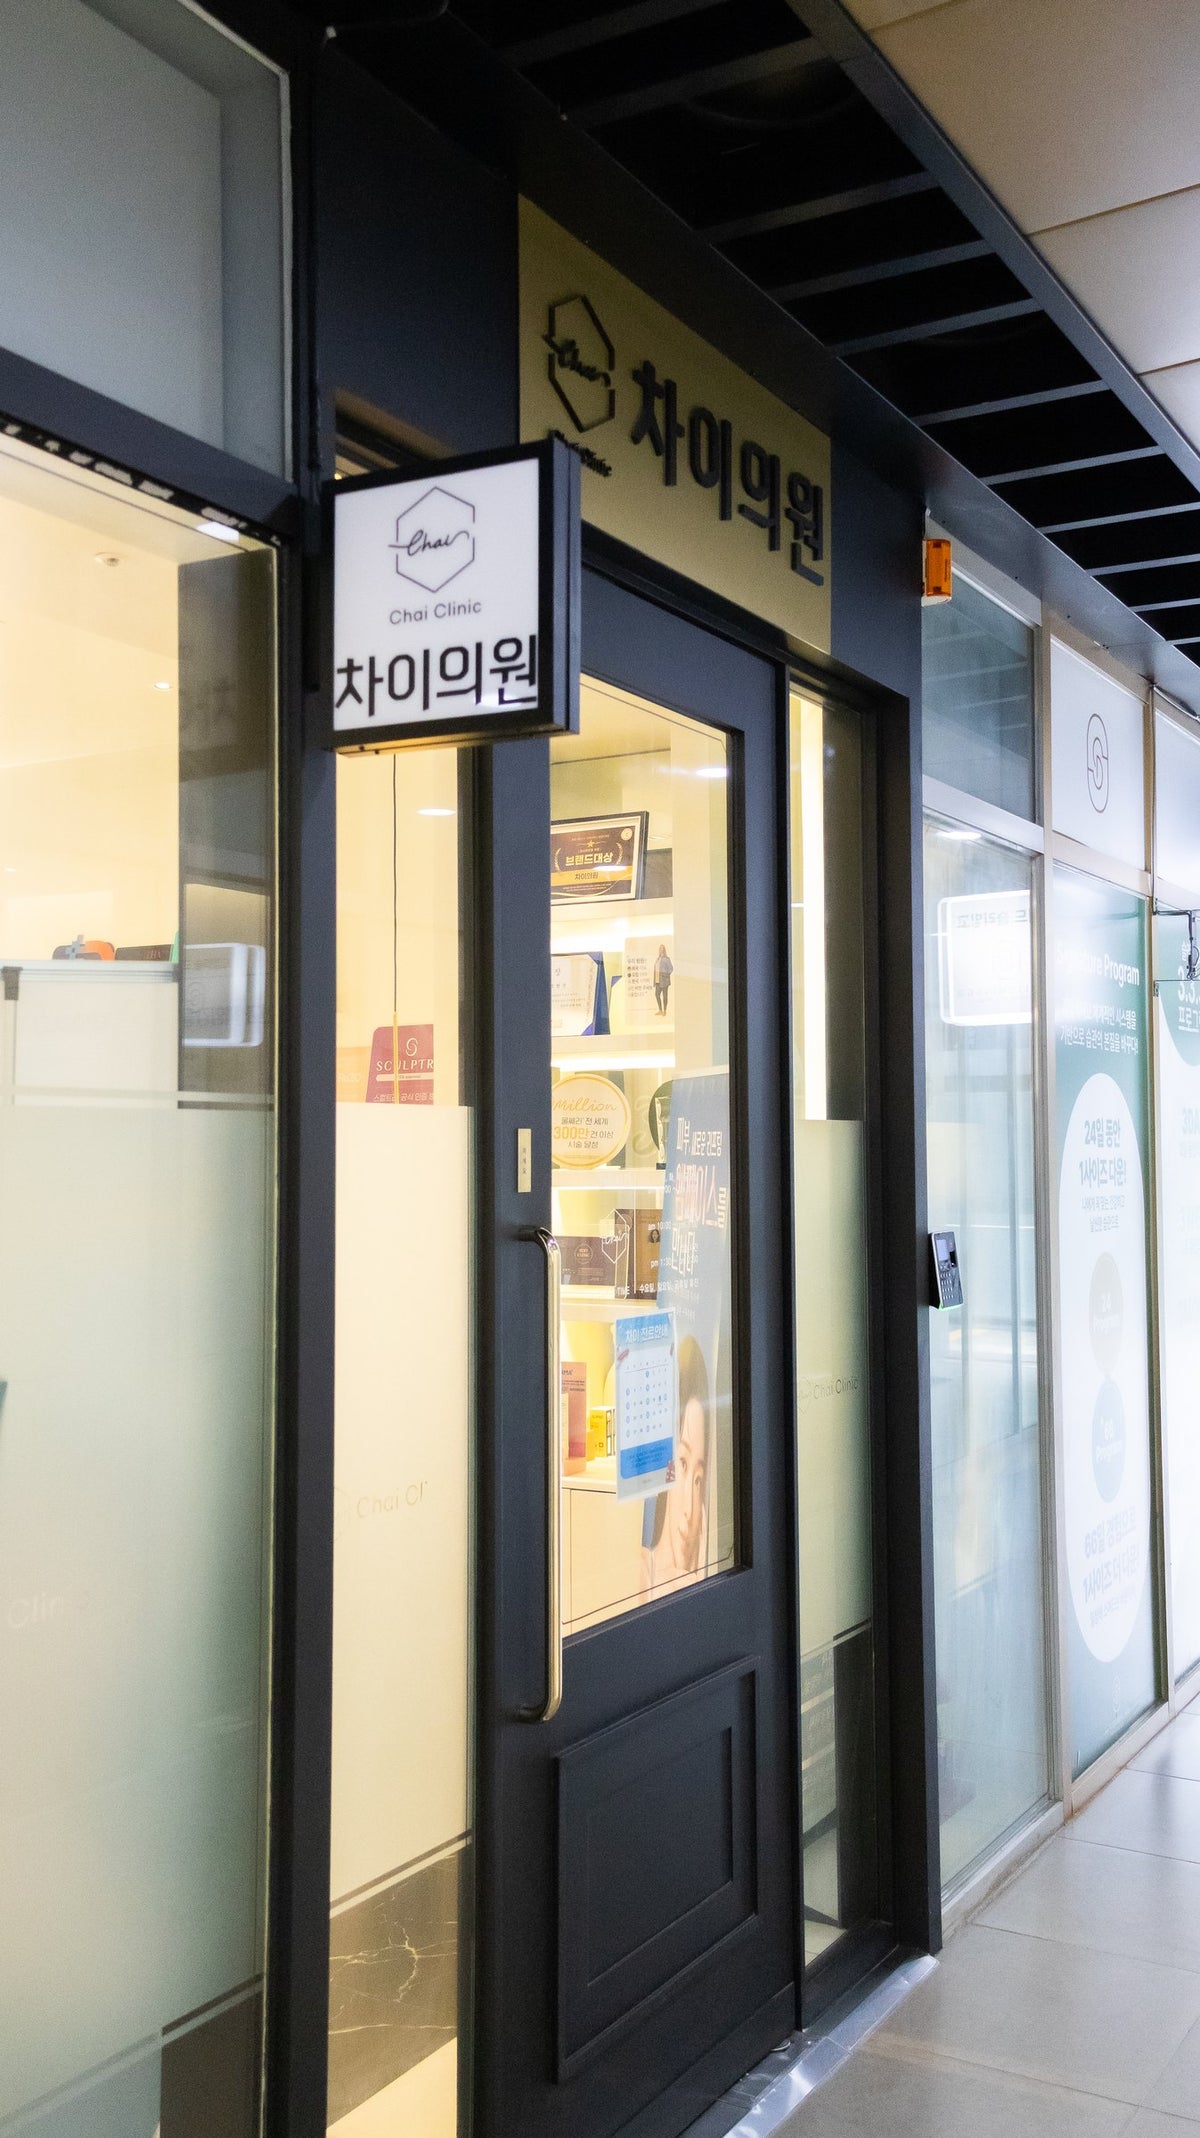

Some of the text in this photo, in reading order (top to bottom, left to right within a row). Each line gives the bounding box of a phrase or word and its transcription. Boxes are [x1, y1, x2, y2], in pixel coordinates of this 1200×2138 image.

[631, 360, 824, 587] 차이의원
[388, 530, 470, 564] Chai
[389, 599, 482, 625] Chai Clinic
[334, 634, 538, 718] 차이의원
[565, 852, 614, 867] 브랜드대상
[1103, 953, 1140, 988] Program
[1116, 1008, 1137, 1031] 시스템을
[1060, 1025, 1085, 1046] 기반으로
[1086, 1029, 1103, 1050] 습관의
[1104, 1031, 1121, 1053] 본질을
[553, 1096, 618, 1112] Million
[553, 1126, 615, 1140] 300만 건 이상
[585, 1116, 593, 1126] 전
[593, 1116, 609, 1126] 세계
[1084, 1118, 1121, 1148] 24일 동안
[567, 1140, 599, 1150] 시술 달성
[1079, 1156, 1127, 1189] 1사이즈 다운!
[1083, 1560, 1113, 1604] 1사이즈
